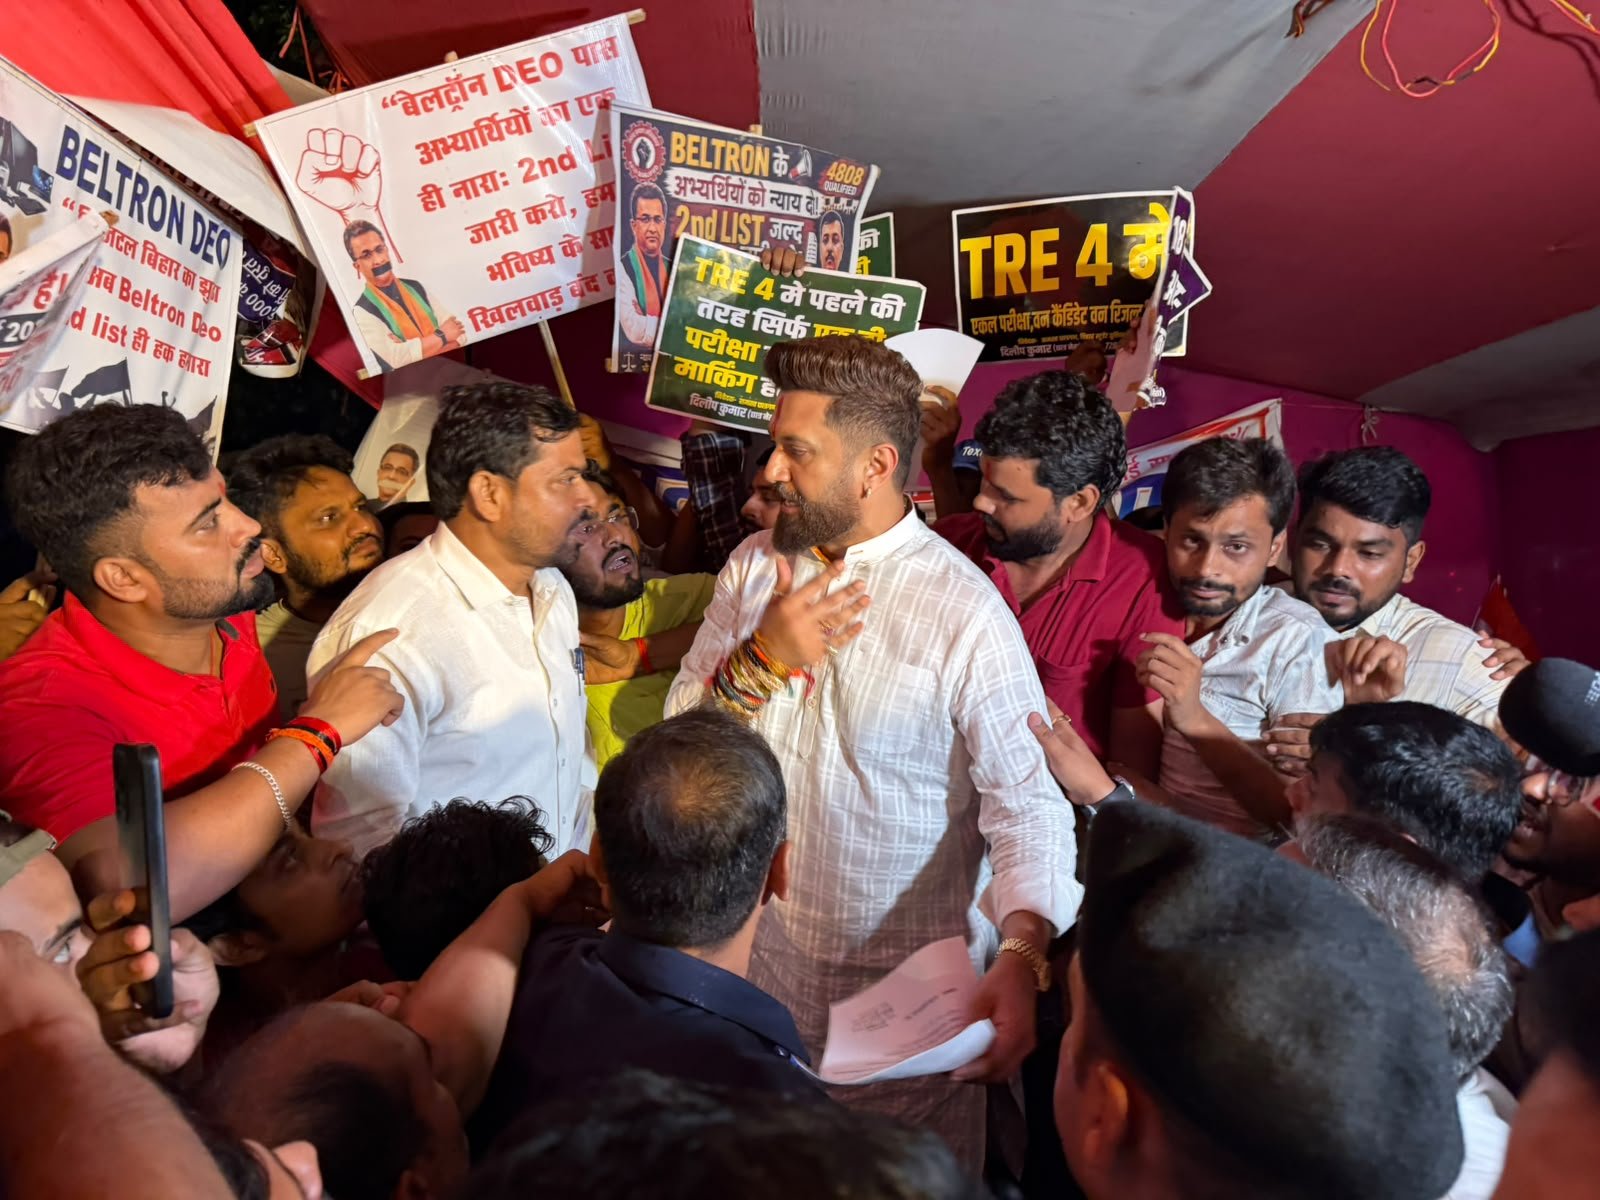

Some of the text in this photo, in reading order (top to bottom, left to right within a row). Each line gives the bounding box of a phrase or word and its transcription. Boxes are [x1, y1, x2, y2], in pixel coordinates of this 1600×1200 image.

[493, 51, 564, 92] DEO
[571, 36, 621, 66] पास
[536, 100, 572, 127] का
[417, 183, 446, 213] ही
[449, 170, 510, 201] नारा:
[518, 146, 577, 184] 2nd
[583, 134, 612, 164] Li
[670, 131, 771, 178] BELTRON
[772, 145, 790, 177] के
[826, 161, 865, 186] 4808
[55, 125, 232, 272] BELTRON DEO
[673, 175, 747, 205] अभ्यर्थियों
[747, 181, 767, 207] को
[769, 189, 803, 213] न्याय
[824, 181, 858, 196] QUALIFIED
[464, 208, 520, 244] जारी
[522, 194, 577, 225] करो,
[675, 204, 805, 247] 2nd LIST जल्द
[140, 239, 181, 281] बिहार
[181, 263, 196, 290] का
[486, 245, 556, 282] भविष्य
[558, 233, 585, 258] के
[959, 227, 1060, 300] TRE
[1075, 222, 1113, 287] 4
[118, 277, 186, 329] Beltron
[191, 311, 222, 343] Deo
[467, 286, 566, 333] खिलवाड़
[566, 272, 600, 298] बंद
[693, 256, 749, 296] TRE
[753, 277, 775, 301] 4
[808, 287, 869, 318] पहले
[869, 292, 906, 322] की
[91, 312, 128, 348] list
[131, 326, 151, 354] ही
[152, 338, 176, 365] हक
[697, 296, 750, 329] तरह
[752, 306, 812, 340] सिर्फ
[970, 315, 998, 336] एकल
[1051, 302, 1088, 328] कैंडिडेट
[1089, 304, 1108, 325] वन
[685, 325, 762, 364] परीक्षा
[673, 355, 759, 394] मार्किंग
[689, 392, 717, 411] दिलीप
[718, 401, 748, 417] कुमार
[962, 446, 983, 457] Tex
